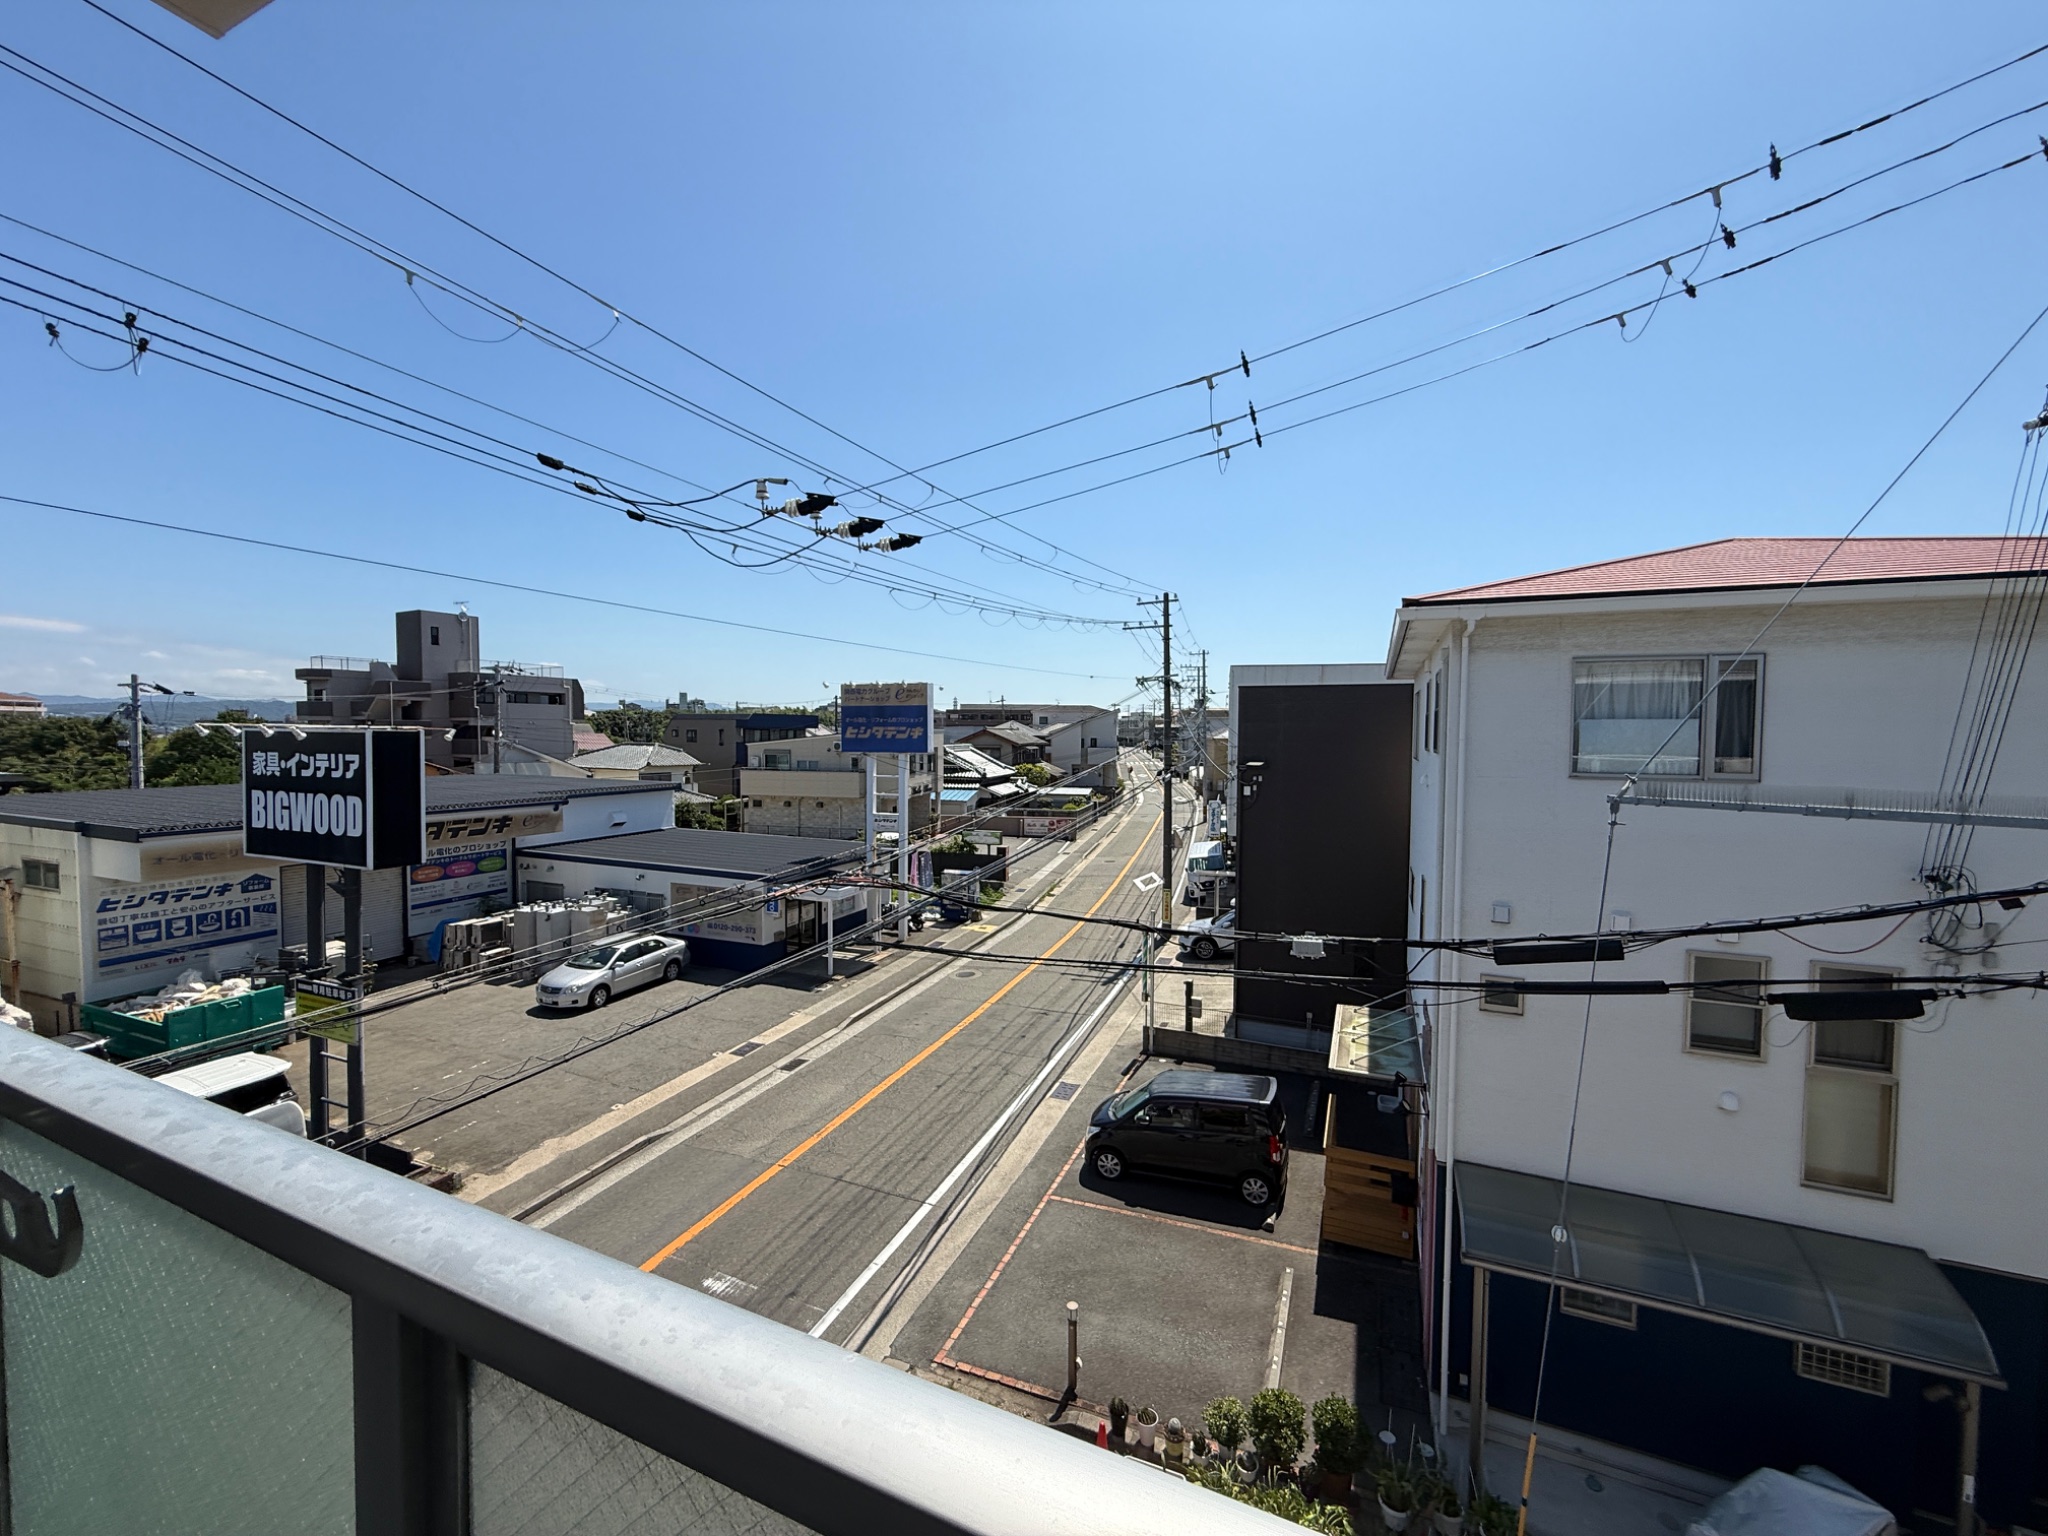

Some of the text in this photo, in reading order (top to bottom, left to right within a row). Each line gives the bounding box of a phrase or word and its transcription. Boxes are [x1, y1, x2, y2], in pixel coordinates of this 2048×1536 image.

[252, 750, 360, 779] 家具・インテリア
[251, 789, 363, 837] BIGWOOD
